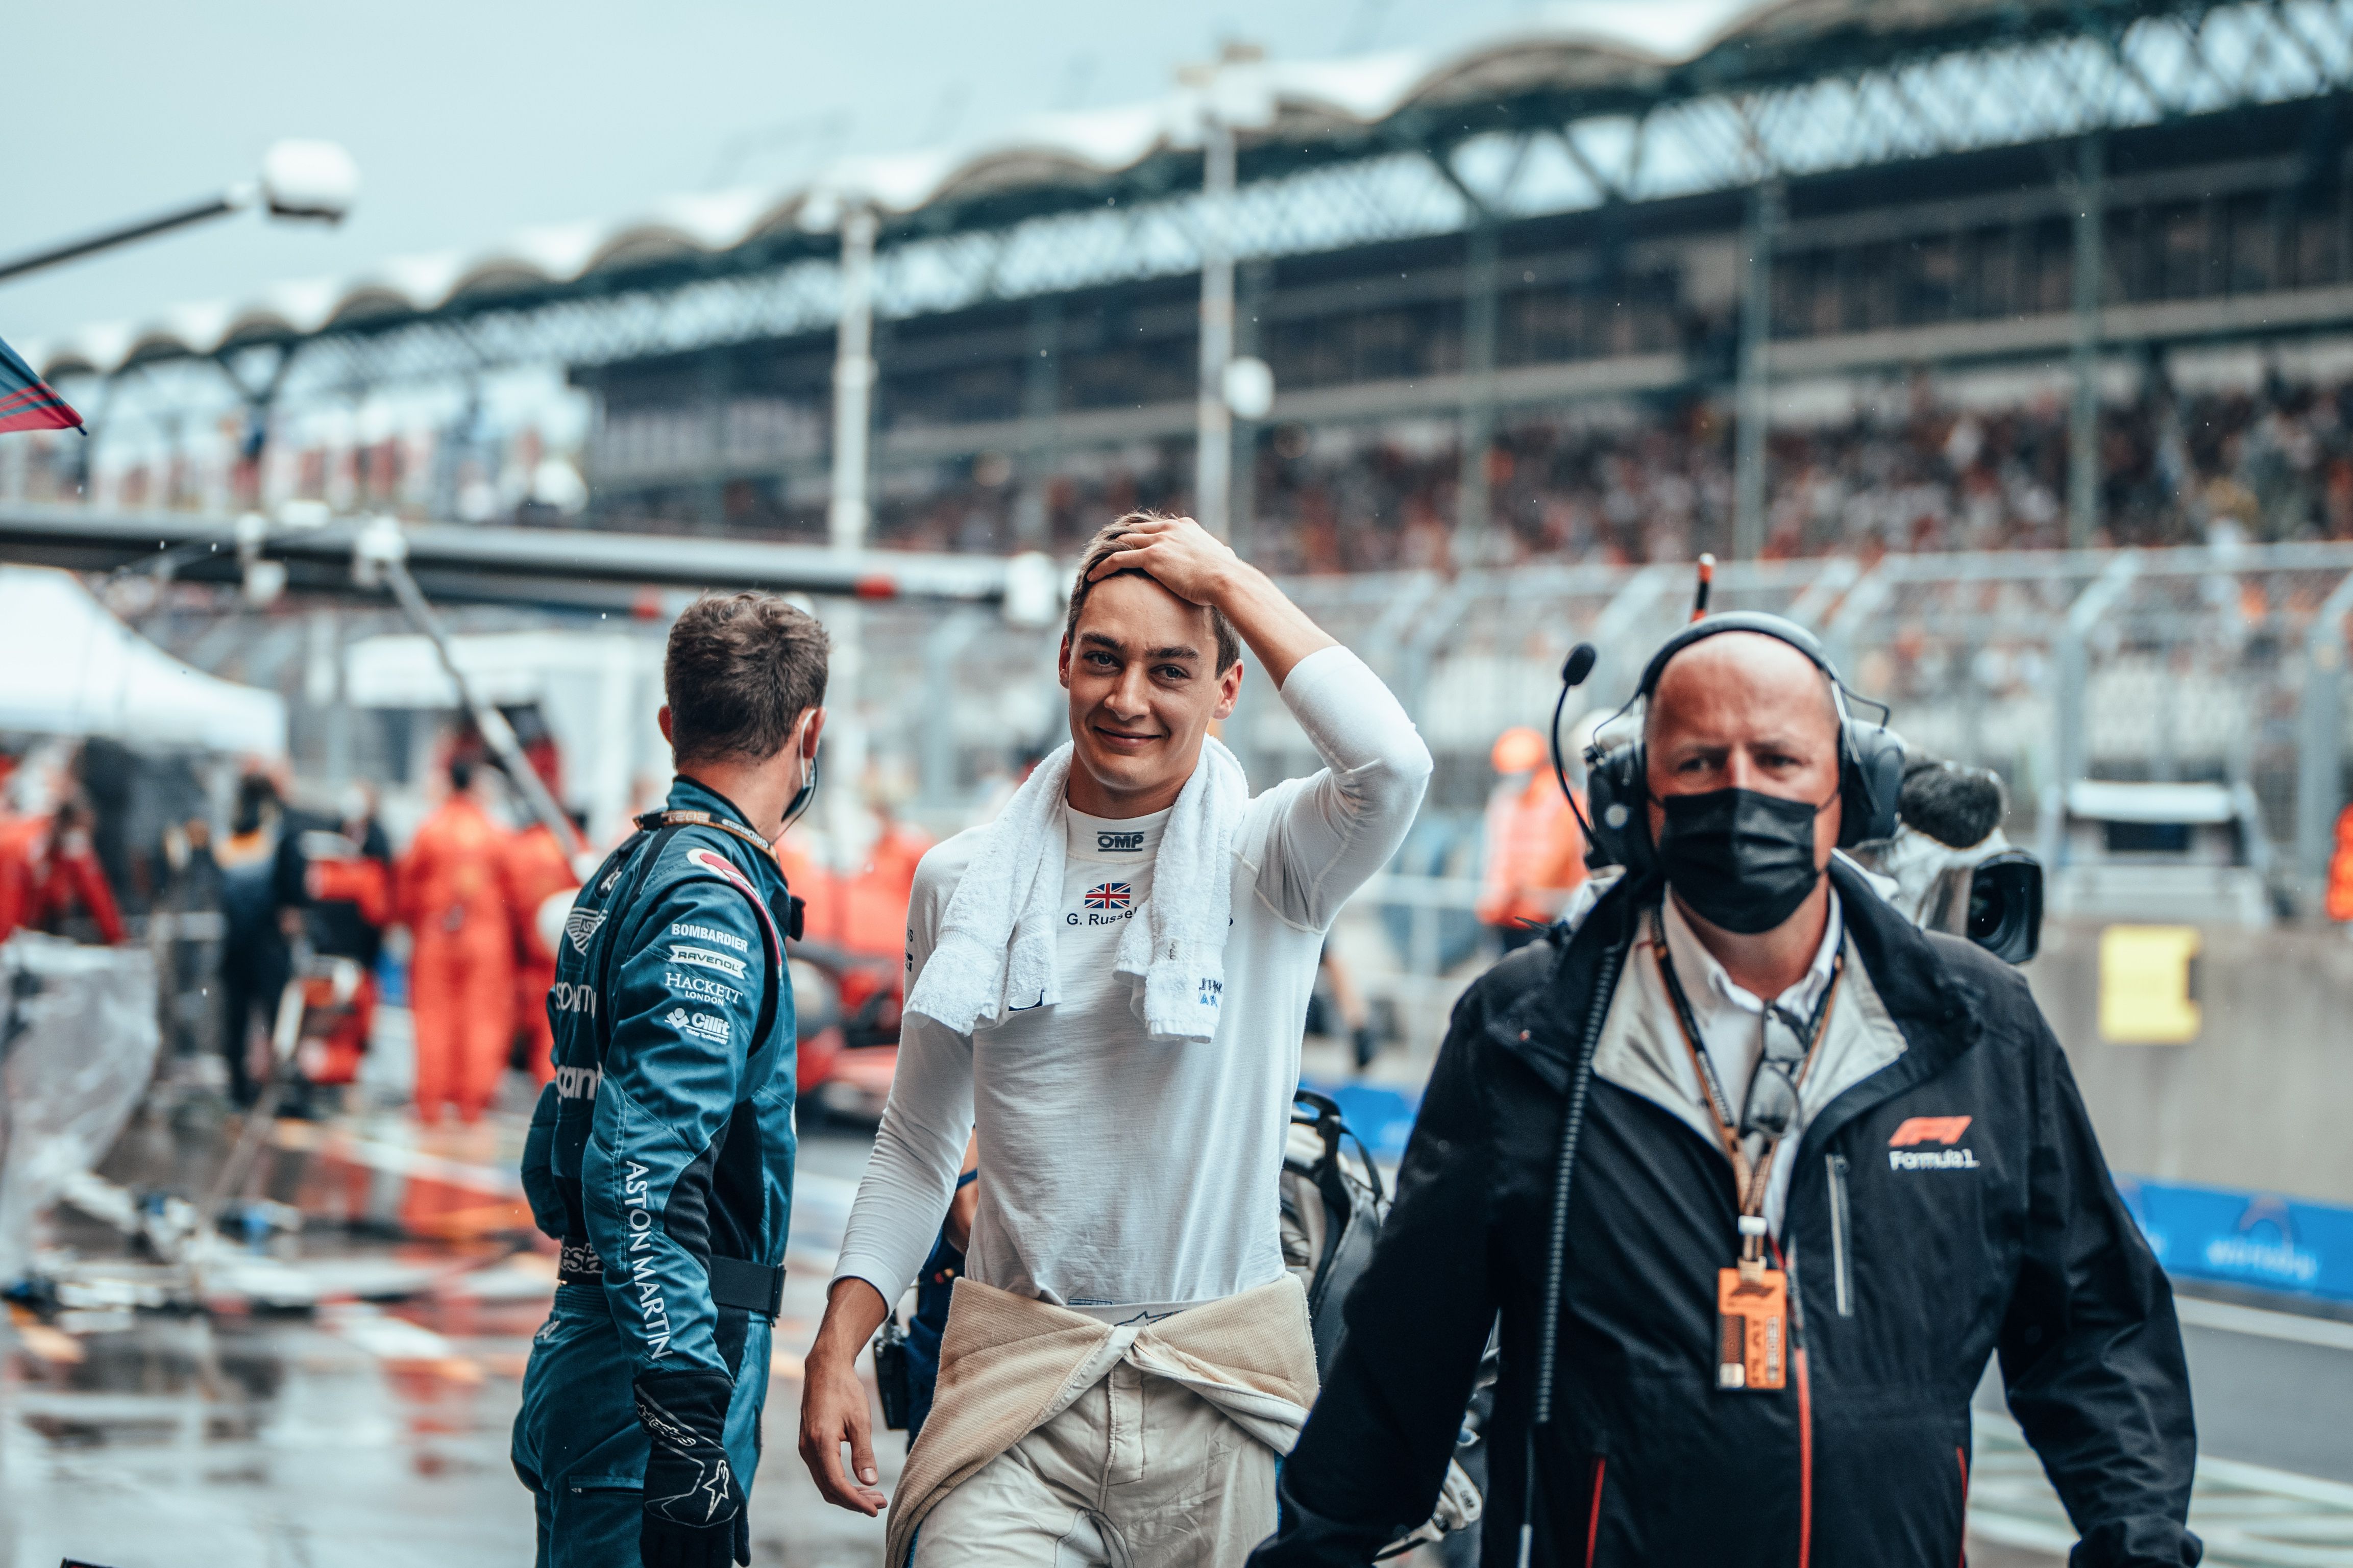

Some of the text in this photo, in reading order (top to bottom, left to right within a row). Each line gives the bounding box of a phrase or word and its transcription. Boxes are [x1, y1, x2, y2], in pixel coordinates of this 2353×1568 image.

[1097, 834, 1144, 848] OMP
[1066, 913, 1082, 925] G.
[671, 923, 748, 954] BOMBARDIER
[678, 951, 739, 972] RAVENOL
[665, 972, 743, 1004] HACKETT
[685, 990, 724, 1007] LONDON
[692, 1012, 730, 1036] Cillit
[625, 1160, 652, 1252] ASTON
[632, 1255, 673, 1360] MARTIN
